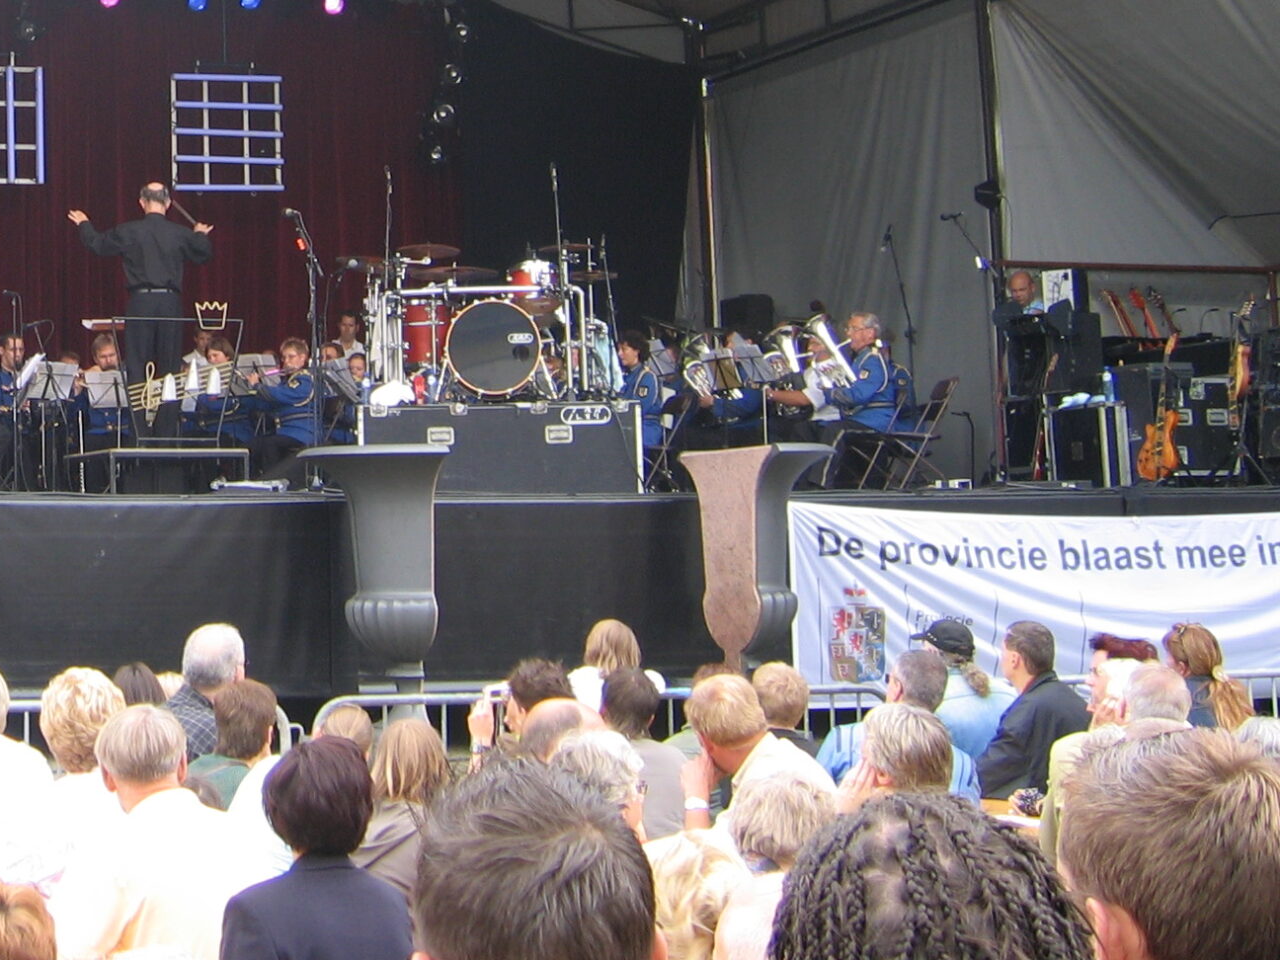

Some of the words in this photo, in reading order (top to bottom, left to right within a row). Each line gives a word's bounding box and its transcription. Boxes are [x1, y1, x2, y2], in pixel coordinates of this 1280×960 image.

[817, 527, 865, 560] De
[879, 537, 1048, 570] provincie
[1060, 538, 1166, 571] blaast
[1175, 544, 1247, 569] mee
